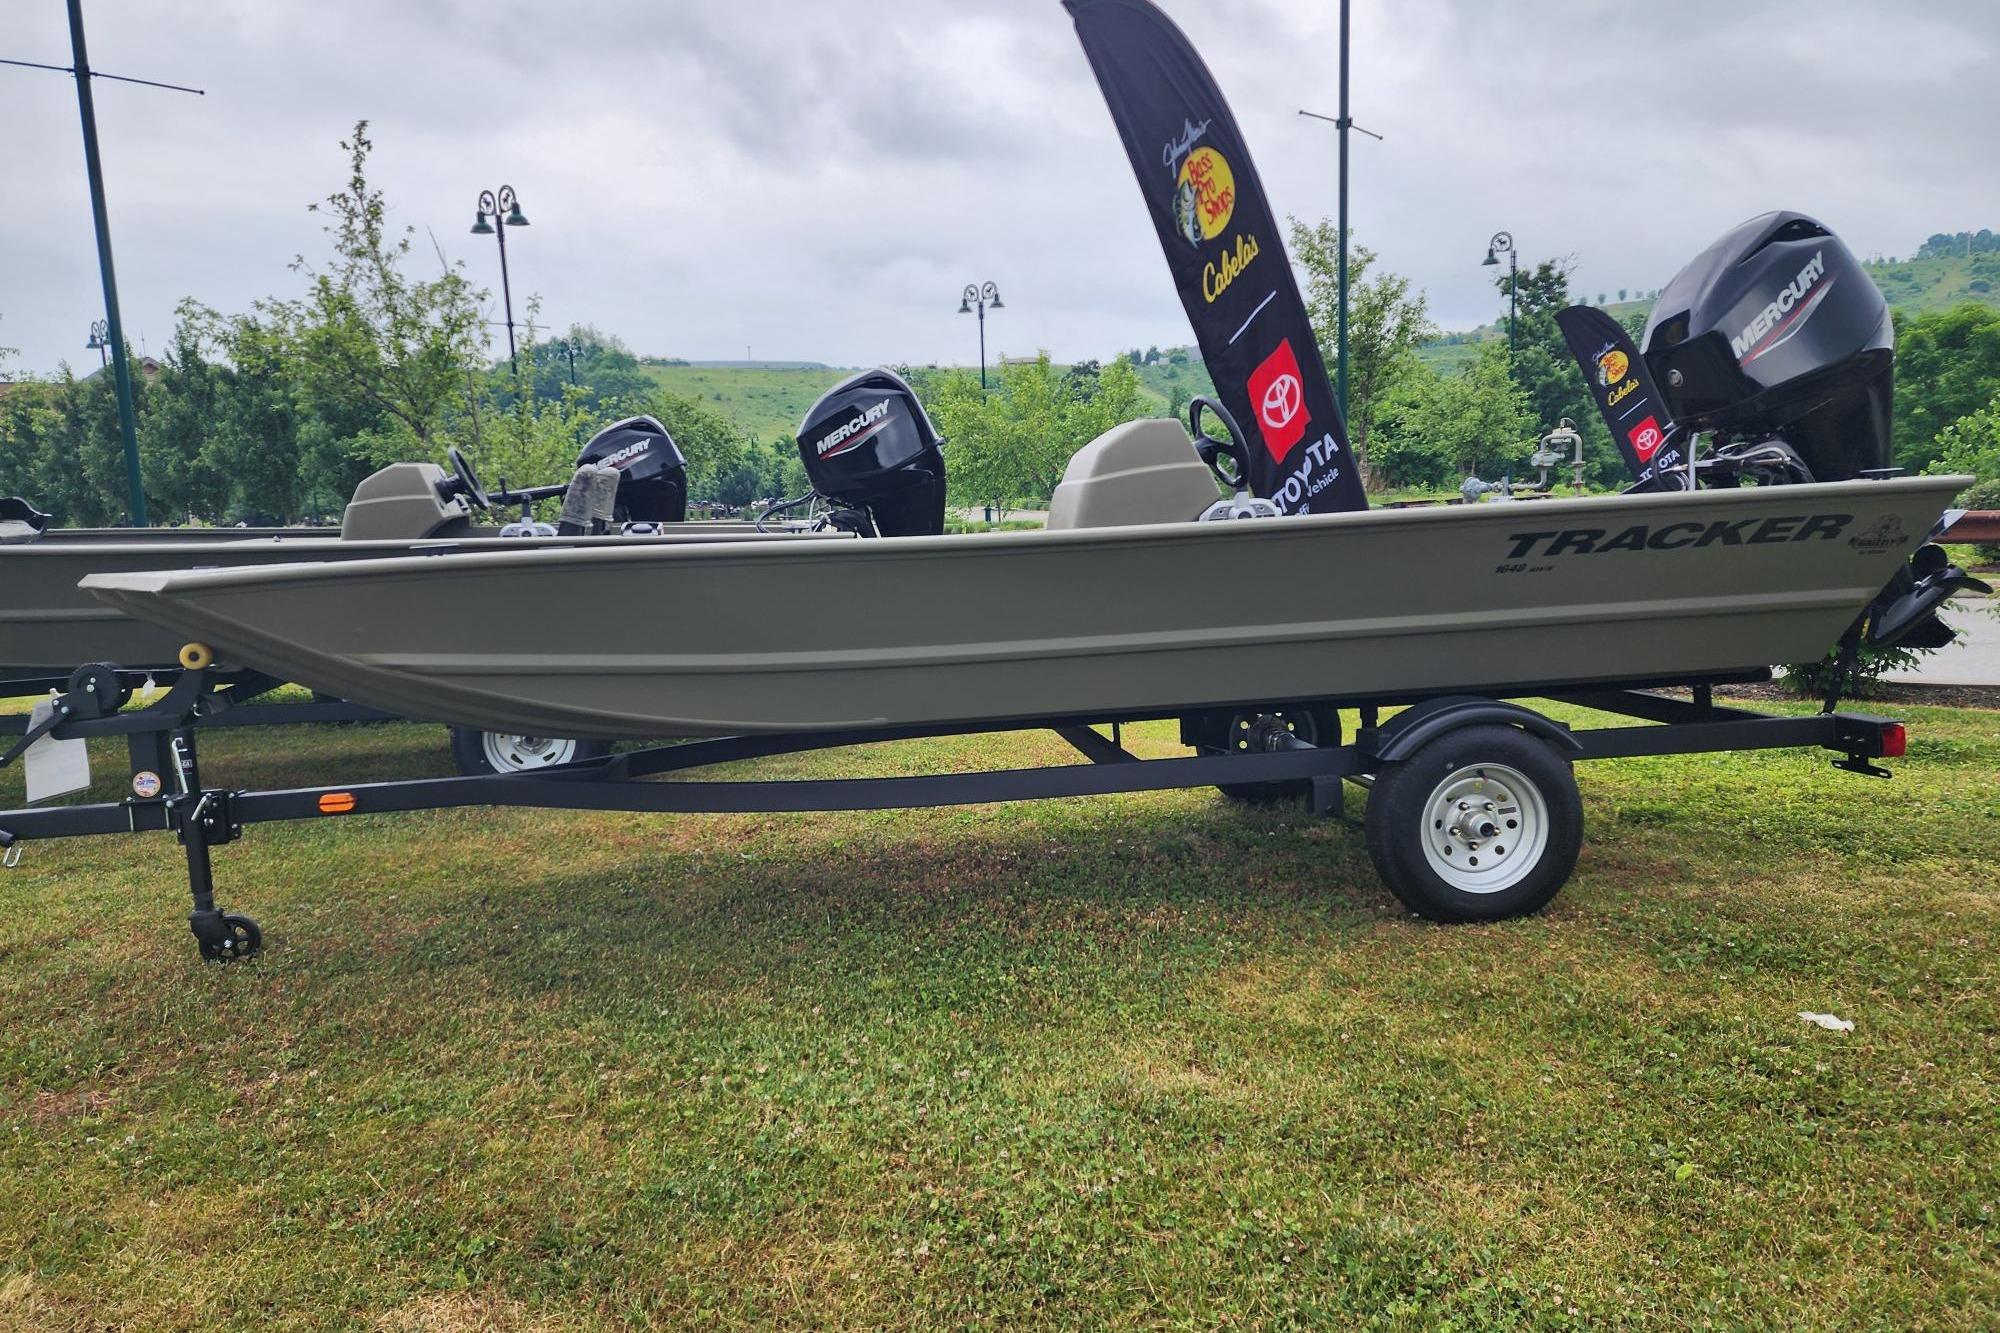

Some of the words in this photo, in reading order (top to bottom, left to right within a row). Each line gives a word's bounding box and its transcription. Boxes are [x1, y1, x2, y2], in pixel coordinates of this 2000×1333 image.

[1188, 152, 1213, 186] Bass
[1196, 178, 1216, 205] Pro
[1205, 186, 1233, 225] Shops
[1203, 233, 1259, 303] Cabela's
[1730, 251, 1825, 359] MERCURY
[816, 398, 890, 455] MERCURY
[1272, 432, 1339, 514] TOYTA
[1640, 449, 1681, 480] TOOTA
[1507, 513, 1855, 559] TRACKER
